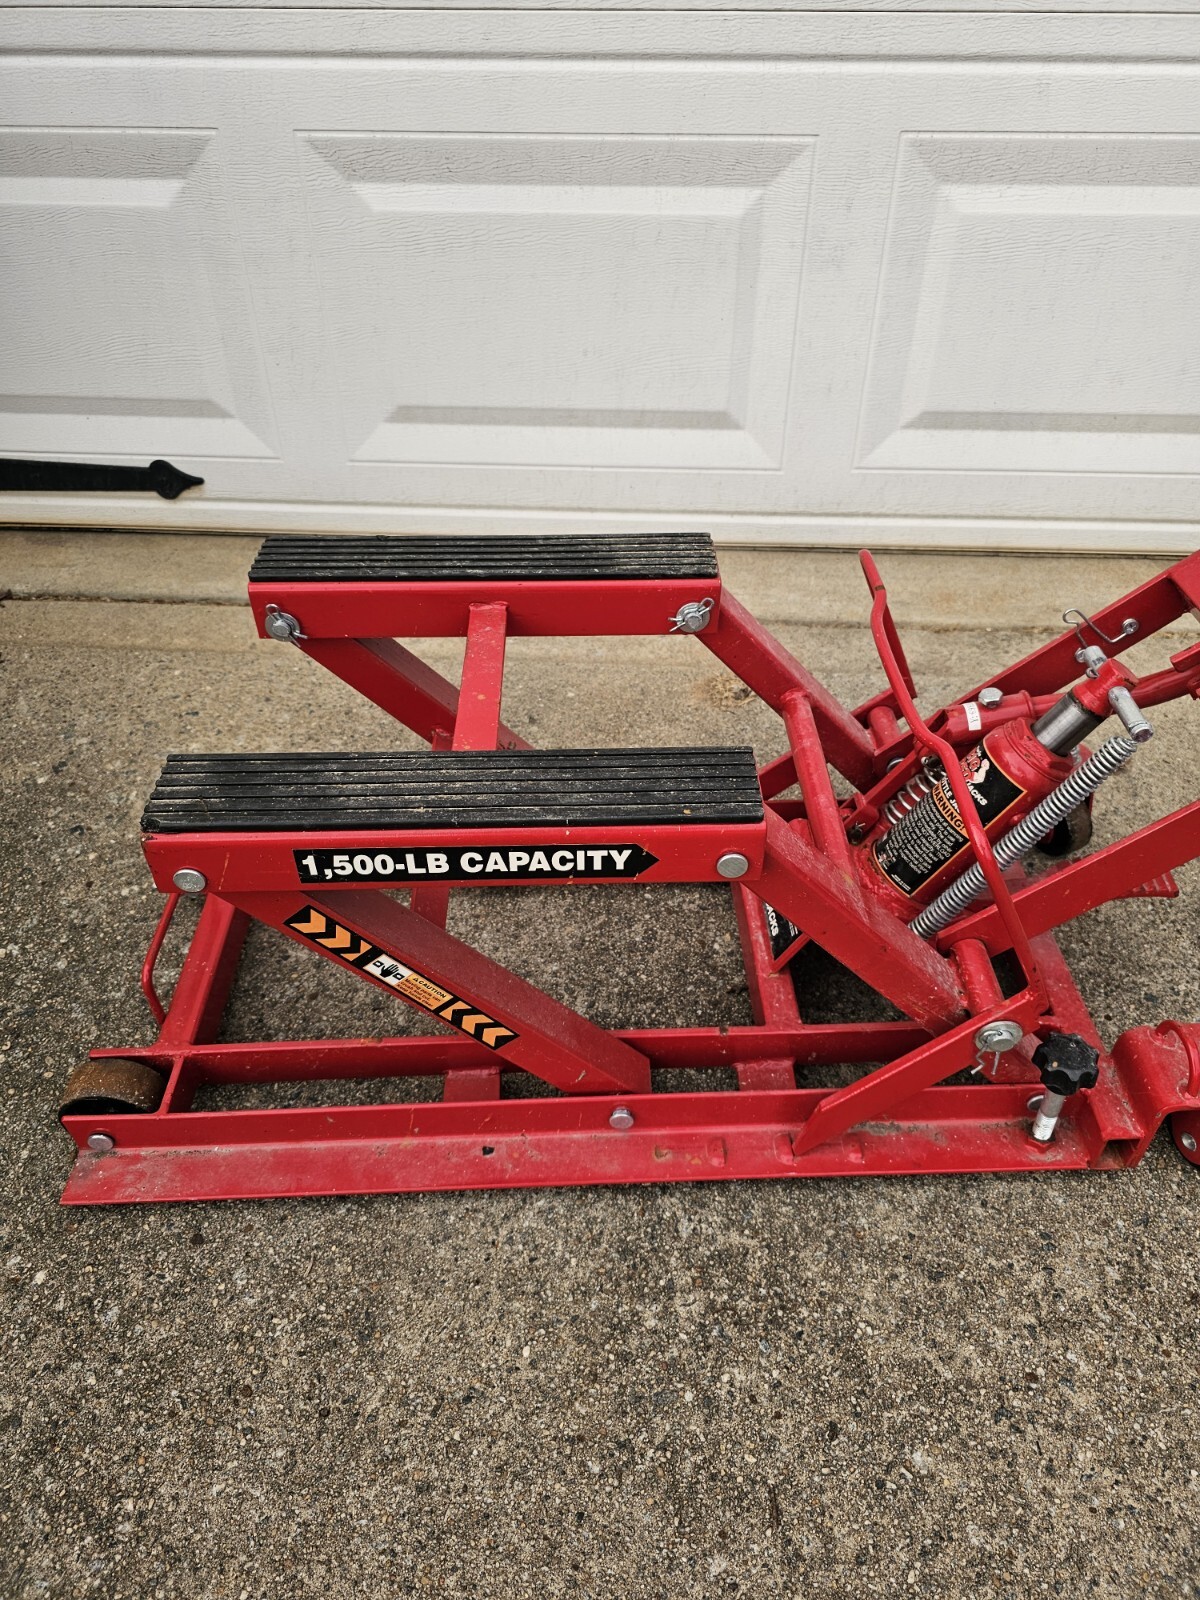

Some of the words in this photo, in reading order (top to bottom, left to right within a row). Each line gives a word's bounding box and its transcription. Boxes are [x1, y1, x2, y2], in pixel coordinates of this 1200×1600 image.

[934, 784, 964, 830] WARNING!
[935, 822, 944, 831] prior
[920, 827, 928, 836] NOT
[927, 836, 950, 857] OVERLOAD
[941, 843, 952, 852] other
[943, 837, 953, 846] load
[903, 848, 918, 864] personal
[906, 843, 919, 858] damage
[913, 843, 923, 854] heed
[922, 853, 932, 863] these
[920, 843, 929, 853] hard
[928, 852, 938, 861] level
[302, 853, 450, 880] 1,500-LB
[460, 850, 632, 874] CAPACITY
[908, 861, 921, 873] before
[765, 902, 779, 937] ACKS
[396, 984, 407, 992] Keep
[408, 991, 422, 1000] hands
[404, 978, 421, 990] Moving
[418, 980, 446, 998] CAUTION
